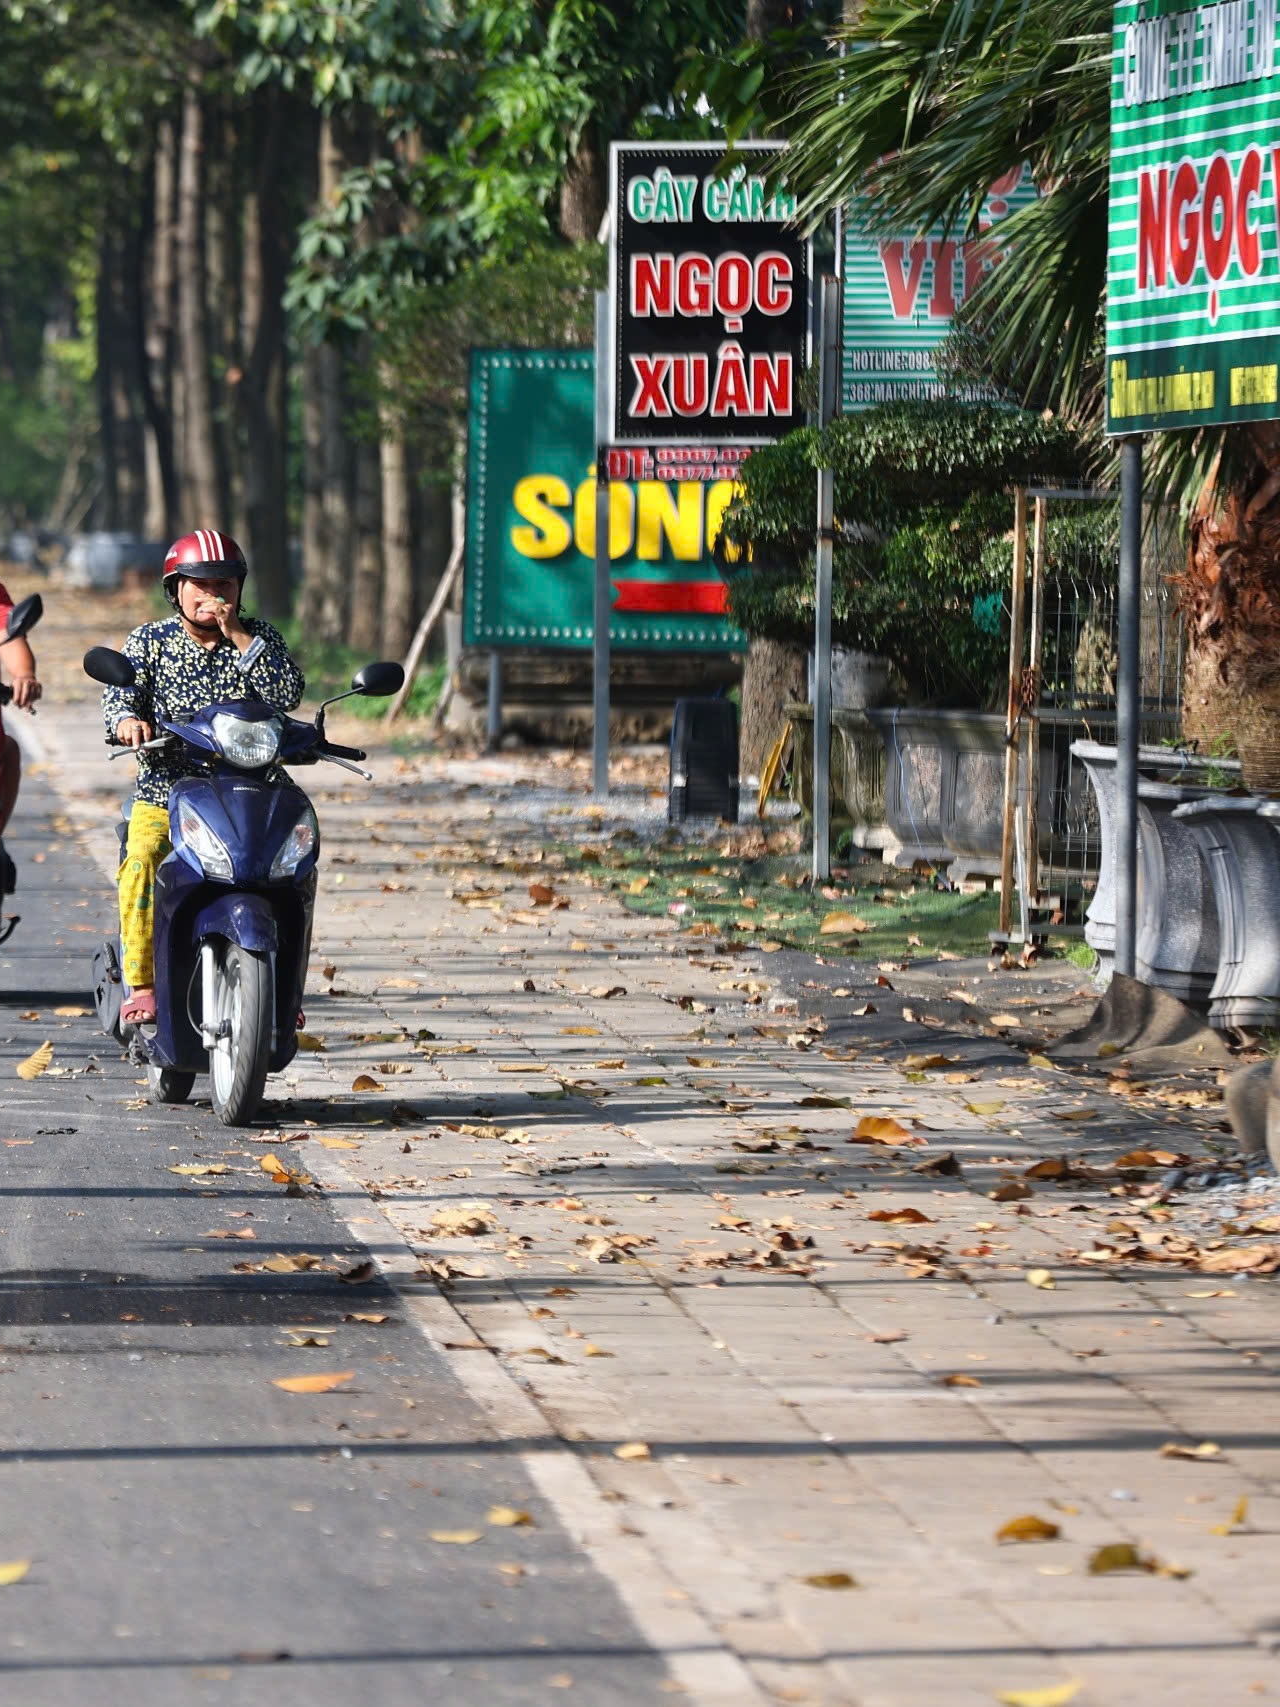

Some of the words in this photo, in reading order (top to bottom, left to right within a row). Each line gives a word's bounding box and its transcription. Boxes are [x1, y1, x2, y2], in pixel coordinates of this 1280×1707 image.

[627, 165, 698, 223] CÂY
[1136, 143, 1263, 326] NGỌC
[630, 251, 793, 333] NGỌC
[628, 339, 793, 418] XUÂN
